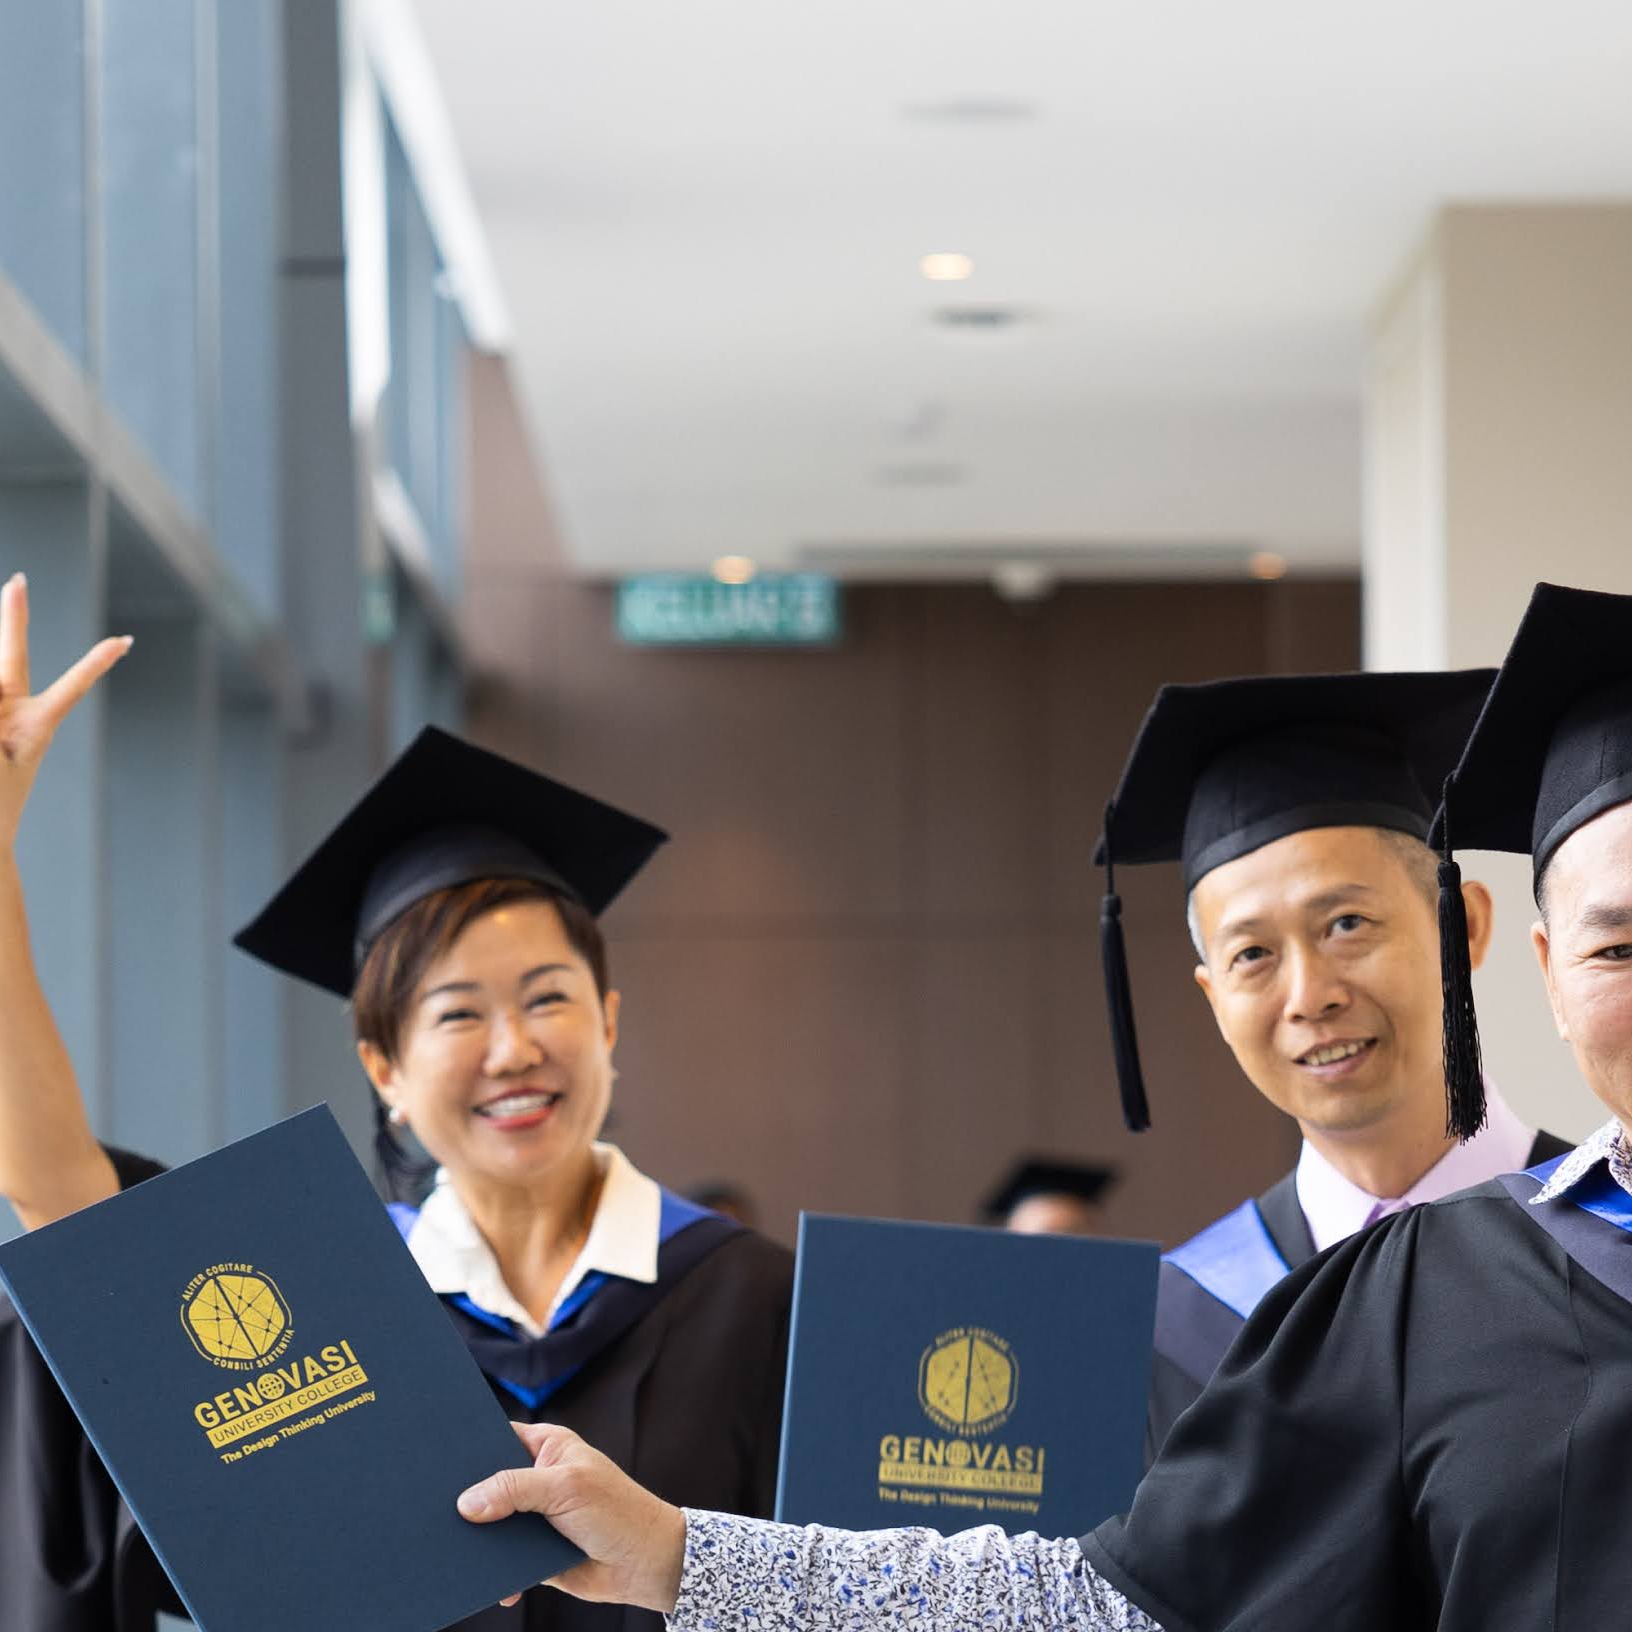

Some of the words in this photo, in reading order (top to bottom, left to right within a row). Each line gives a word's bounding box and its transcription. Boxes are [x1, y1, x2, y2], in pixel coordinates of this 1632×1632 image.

[182, 1273, 207, 1301] ALITER
[206, 1263, 253, 1277] COGITARE
[193, 1339, 359, 1429] GENOVASI
[213, 1400, 294, 1443] UNIVERSITY
[296, 1369, 363, 1406] COLLEGE
[220, 1449, 243, 1464] The
[242, 1432, 279, 1456] Design
[278, 1412, 326, 1438] Thinking
[324, 1391, 376, 1419] University
[879, 1434, 1045, 1474] GENOVASI
[884, 1465, 970, 1482] UNIVERSITY
[971, 1472, 1039, 1490] COLLEGE
